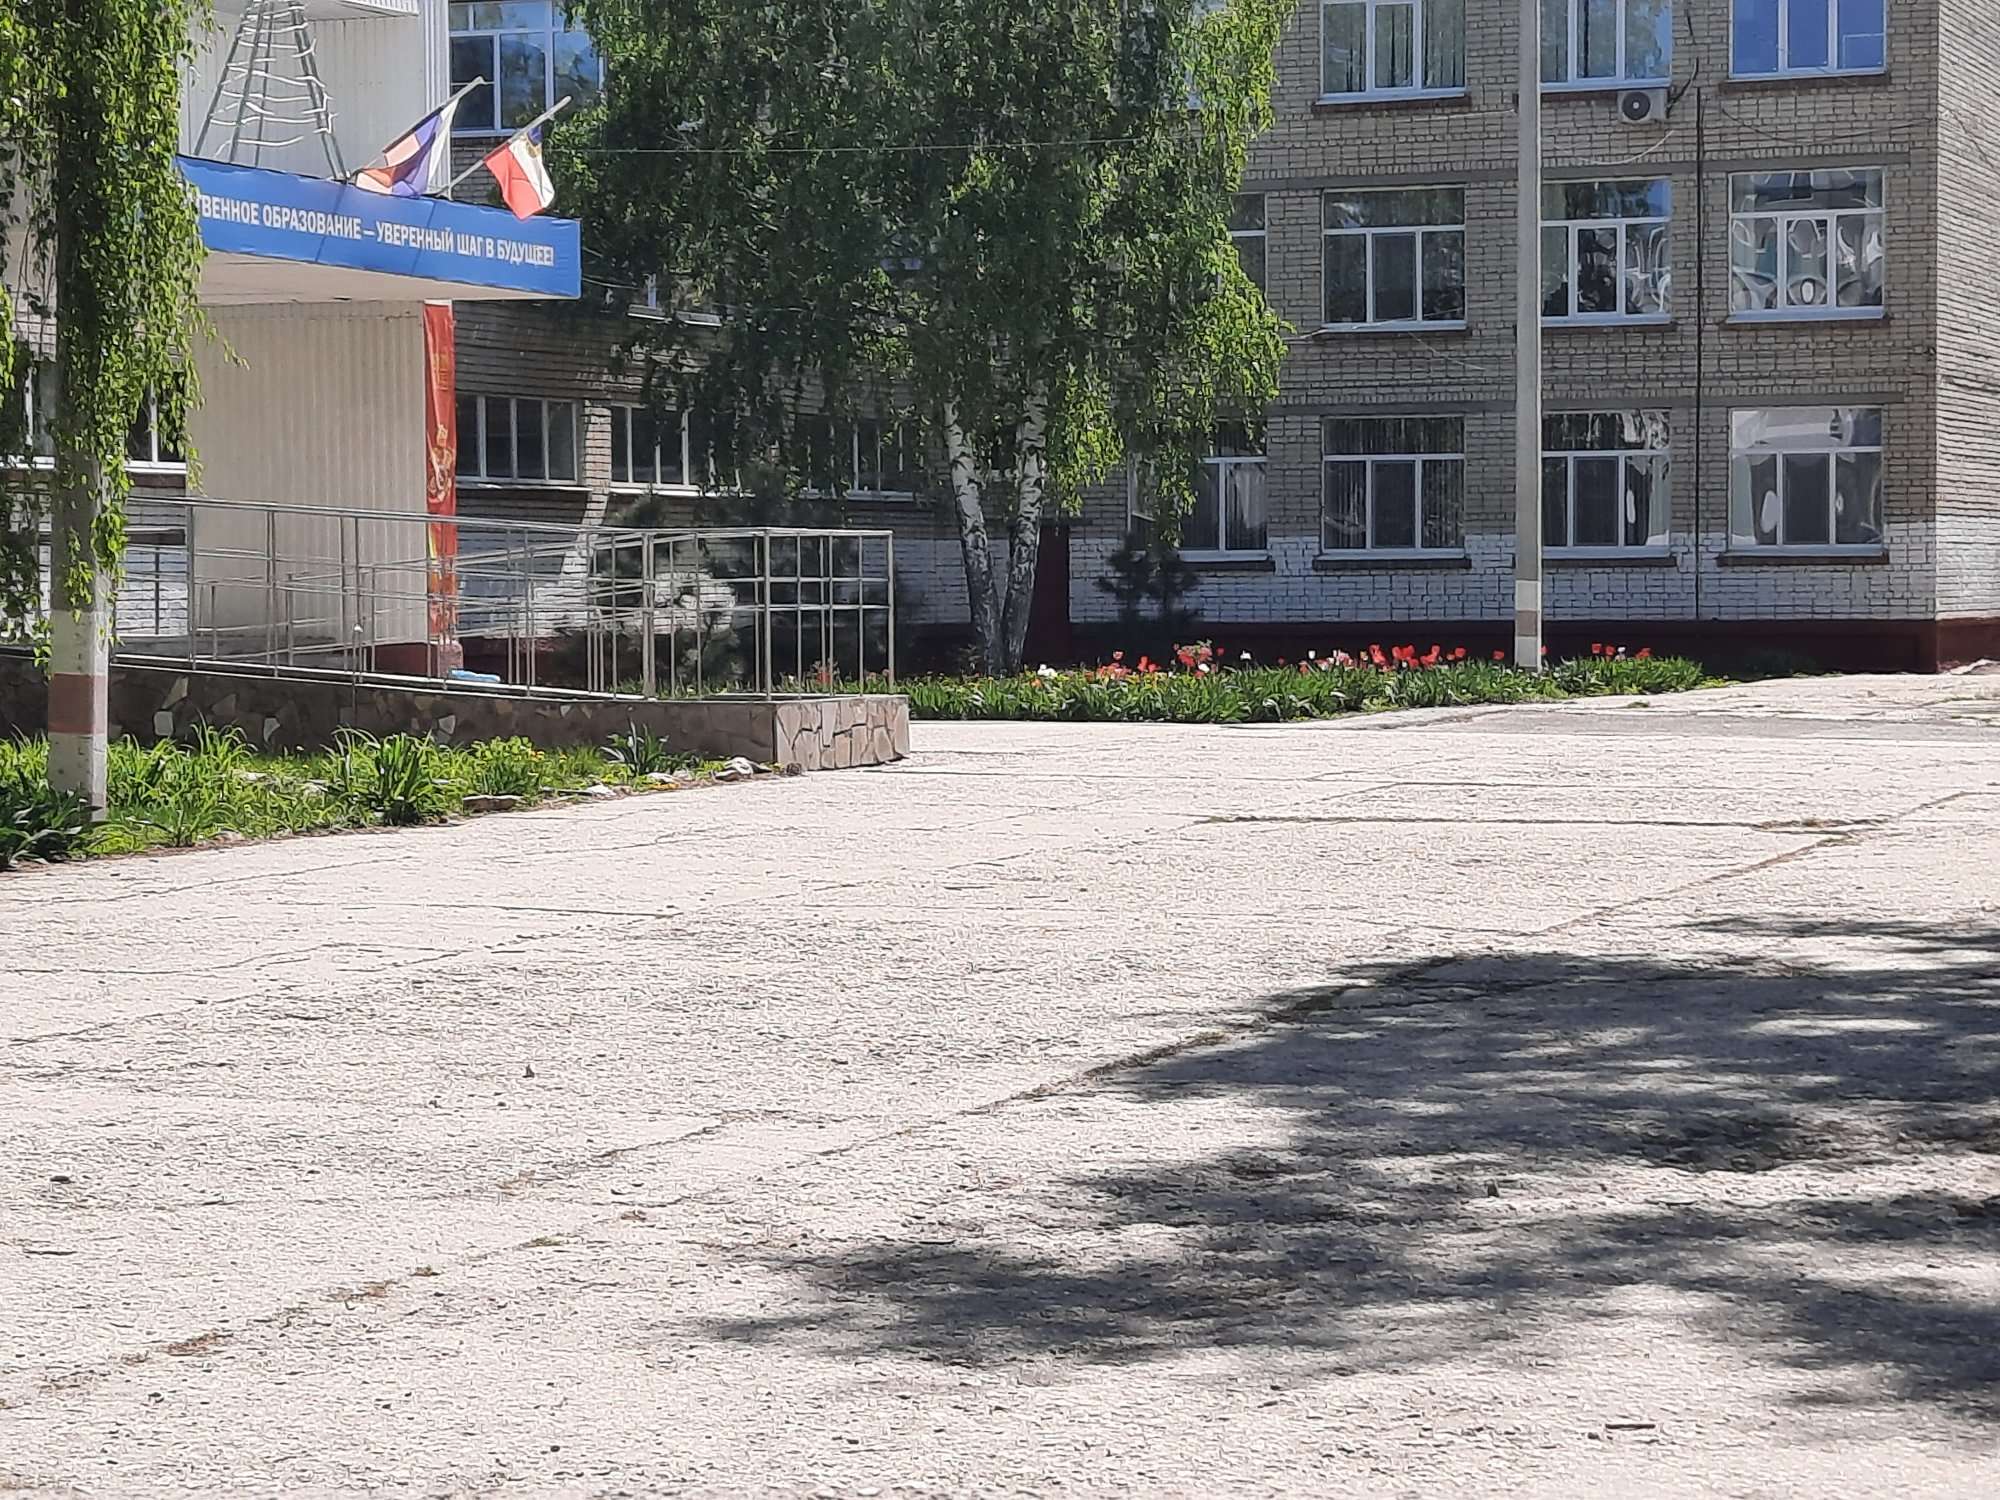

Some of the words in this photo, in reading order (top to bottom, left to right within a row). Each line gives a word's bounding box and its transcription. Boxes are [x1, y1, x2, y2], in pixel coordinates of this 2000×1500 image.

[262, 204, 362, 240] ОБРАЗОВАНИЕ
[375, 220, 454, 253] УВЕРЕННЫЙ
[457, 233, 483, 257] ШАГ
[485, 237, 494, 258] В
